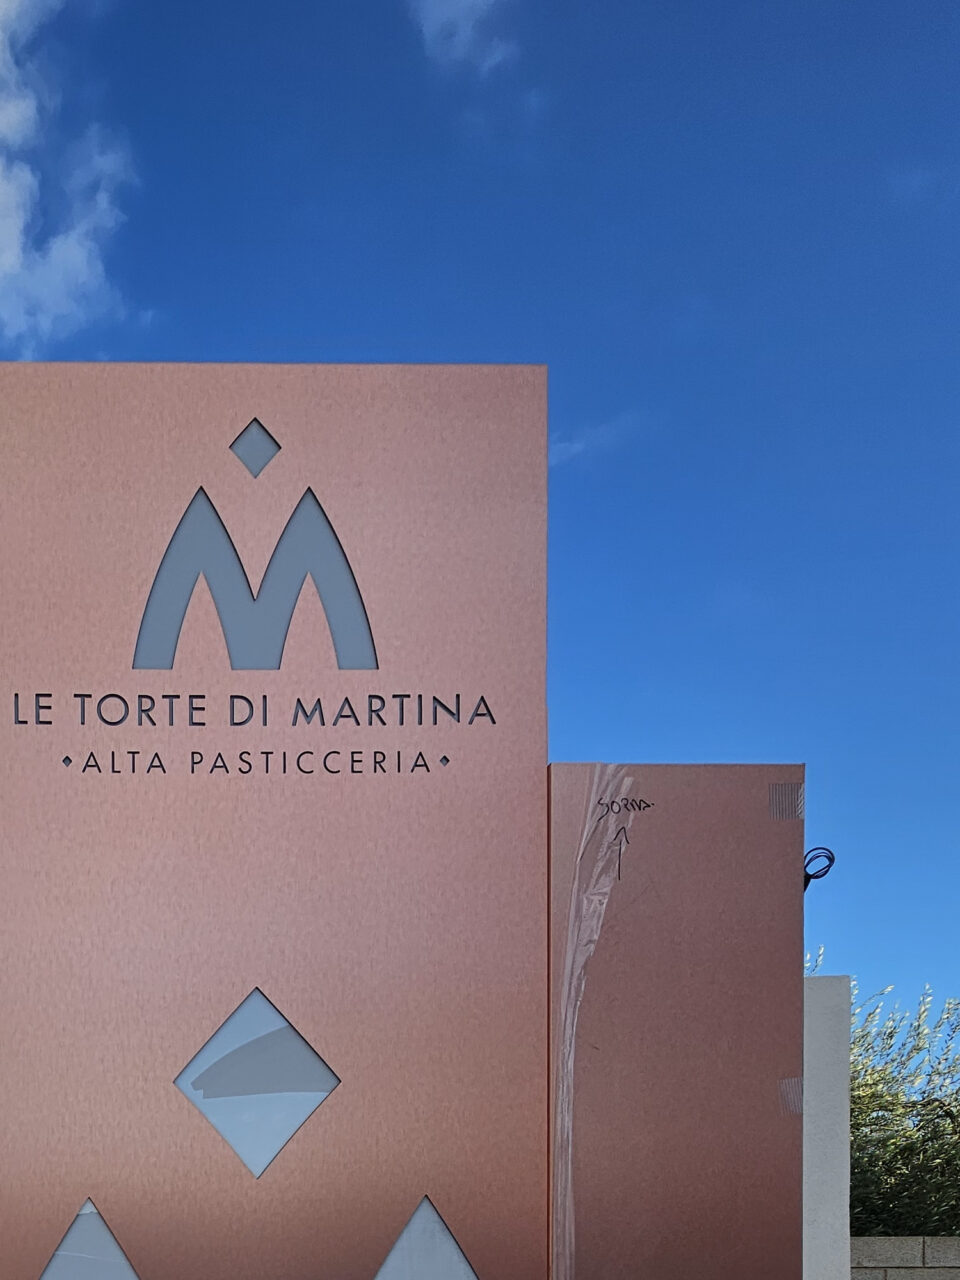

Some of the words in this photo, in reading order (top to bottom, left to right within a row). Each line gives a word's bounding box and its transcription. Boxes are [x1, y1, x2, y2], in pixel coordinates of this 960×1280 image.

[14, 692, 53, 725] LE
[73, 693, 206, 727] TORTE
[229, 694, 268, 727] DI
[291, 693, 497, 727] MARTINA
[81, 751, 167, 774] ALTA
[191, 750, 431, 774] PASTICCERIA
